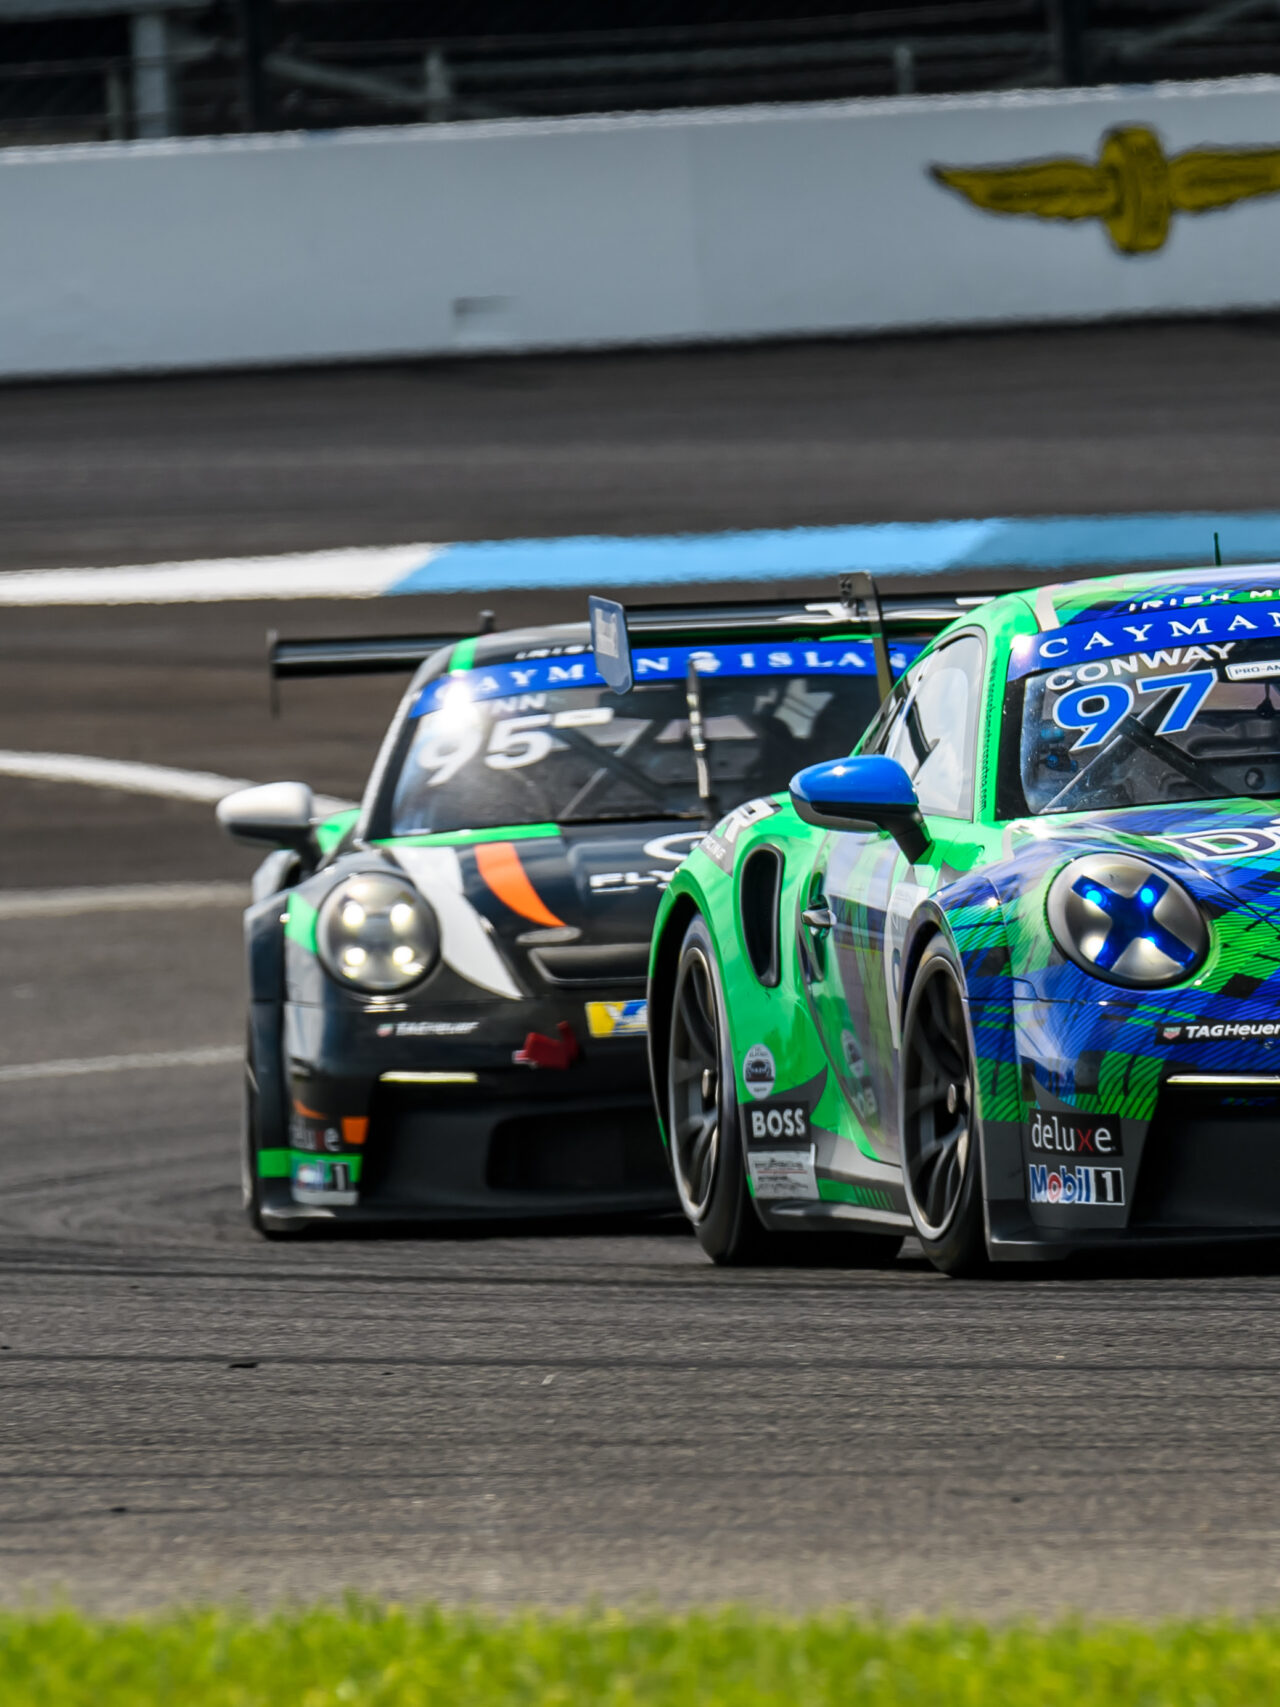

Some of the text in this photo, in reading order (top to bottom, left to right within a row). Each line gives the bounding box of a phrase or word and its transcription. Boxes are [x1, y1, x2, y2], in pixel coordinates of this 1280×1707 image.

[434, 656, 669, 702] AYMN
[1045, 642, 1237, 691] CONWAY
[1052, 668, 1219, 752] 97
[416, 713, 554, 787] 95
[752, 1107, 806, 1139] BOSS
[1031, 1113, 1113, 1153] deluxe
[1029, 1164, 1115, 1204] Mobil 1
